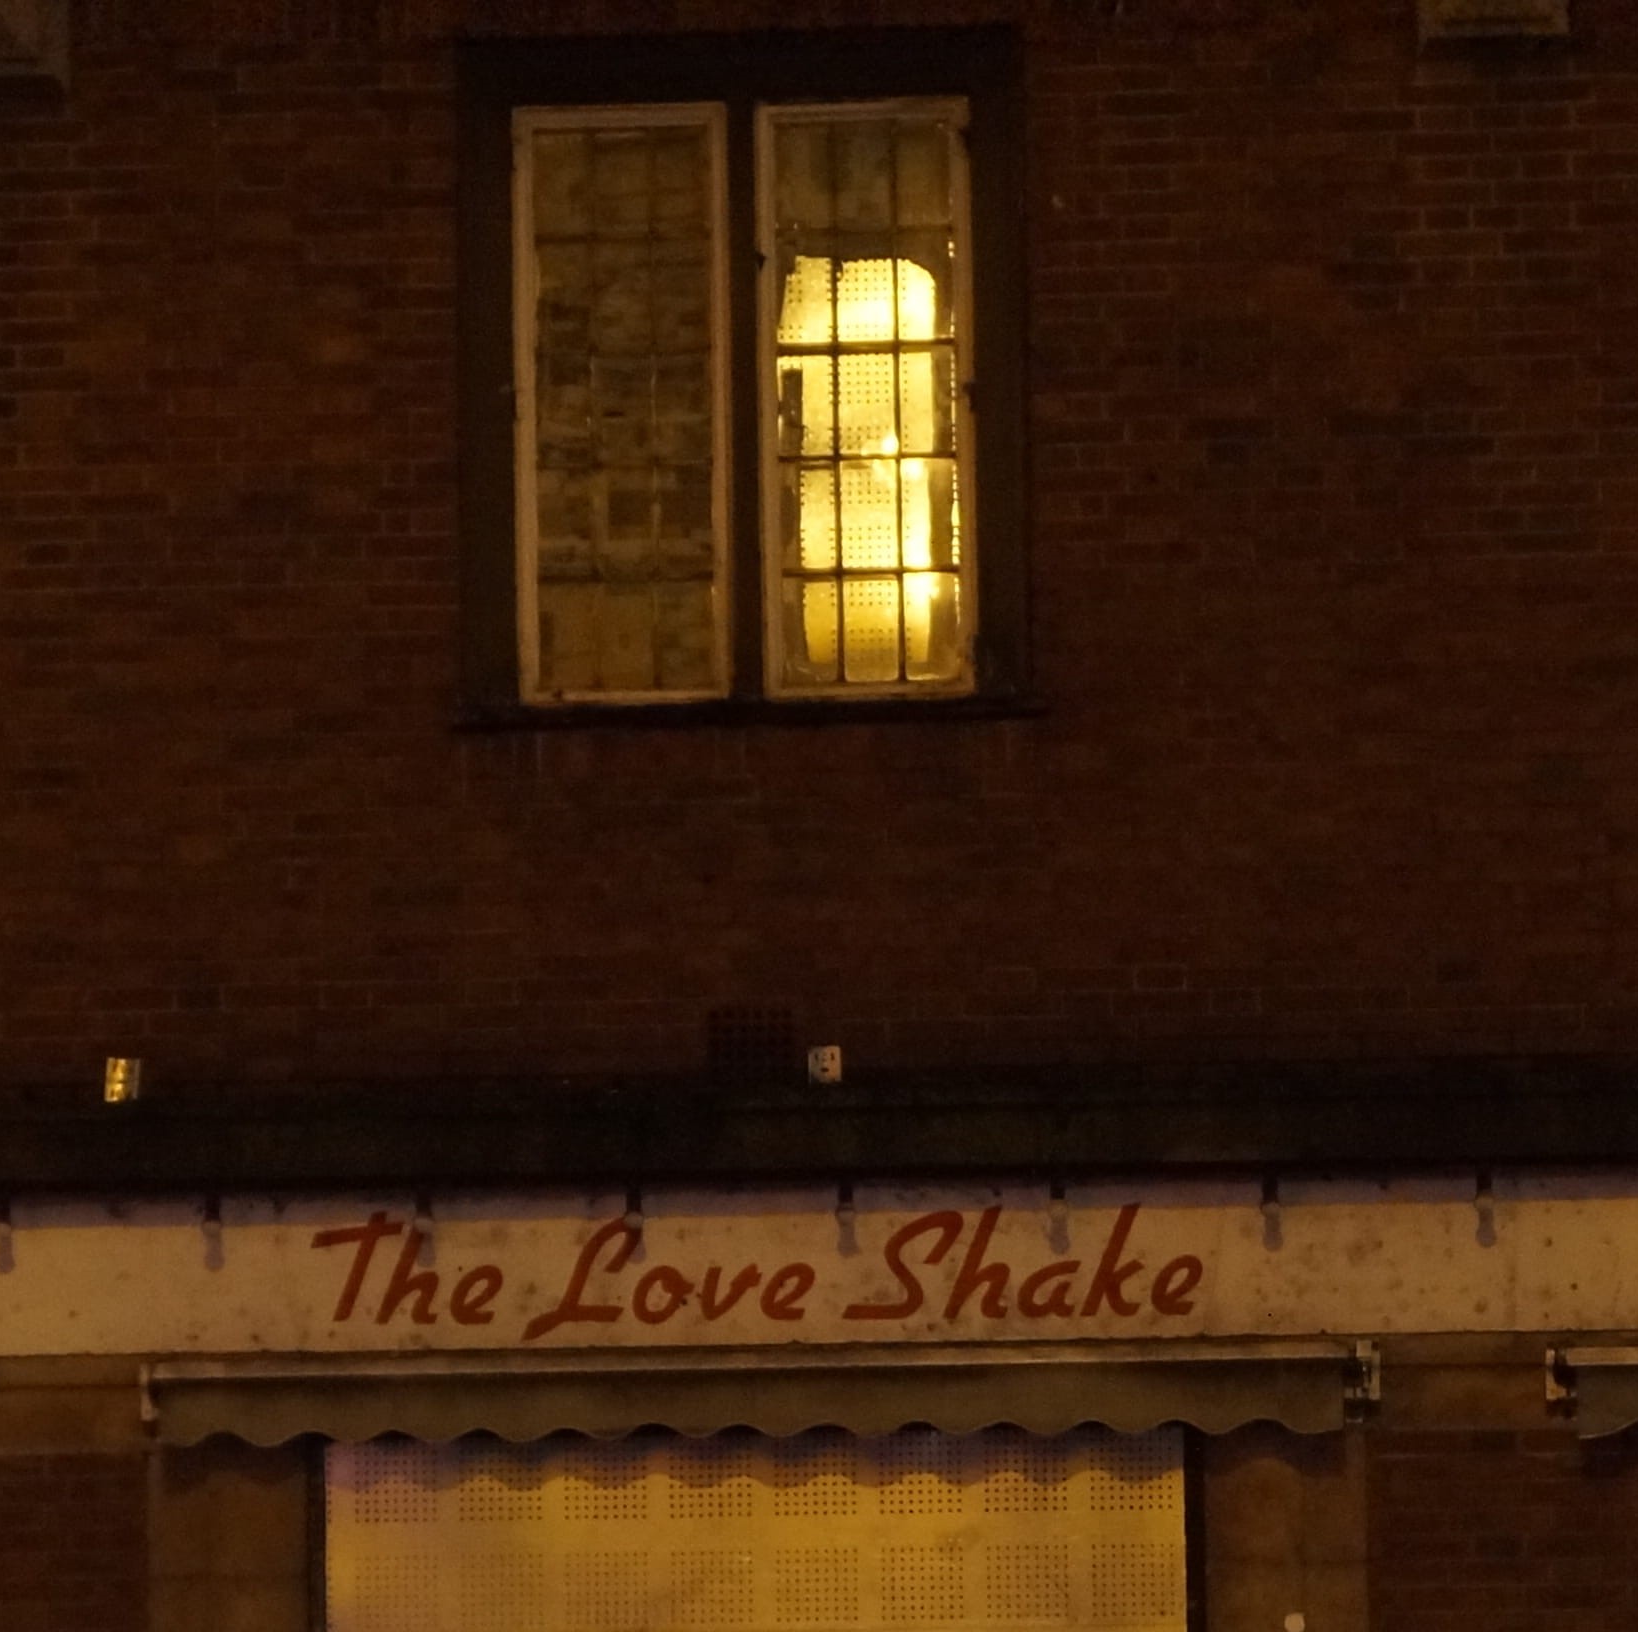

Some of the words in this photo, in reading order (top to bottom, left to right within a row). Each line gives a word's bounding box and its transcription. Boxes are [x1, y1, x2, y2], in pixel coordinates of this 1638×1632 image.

[310, 1209, 504, 1326] The
[521, 1214, 816, 1341] Love
[842, 1203, 1204, 1322] Shake
